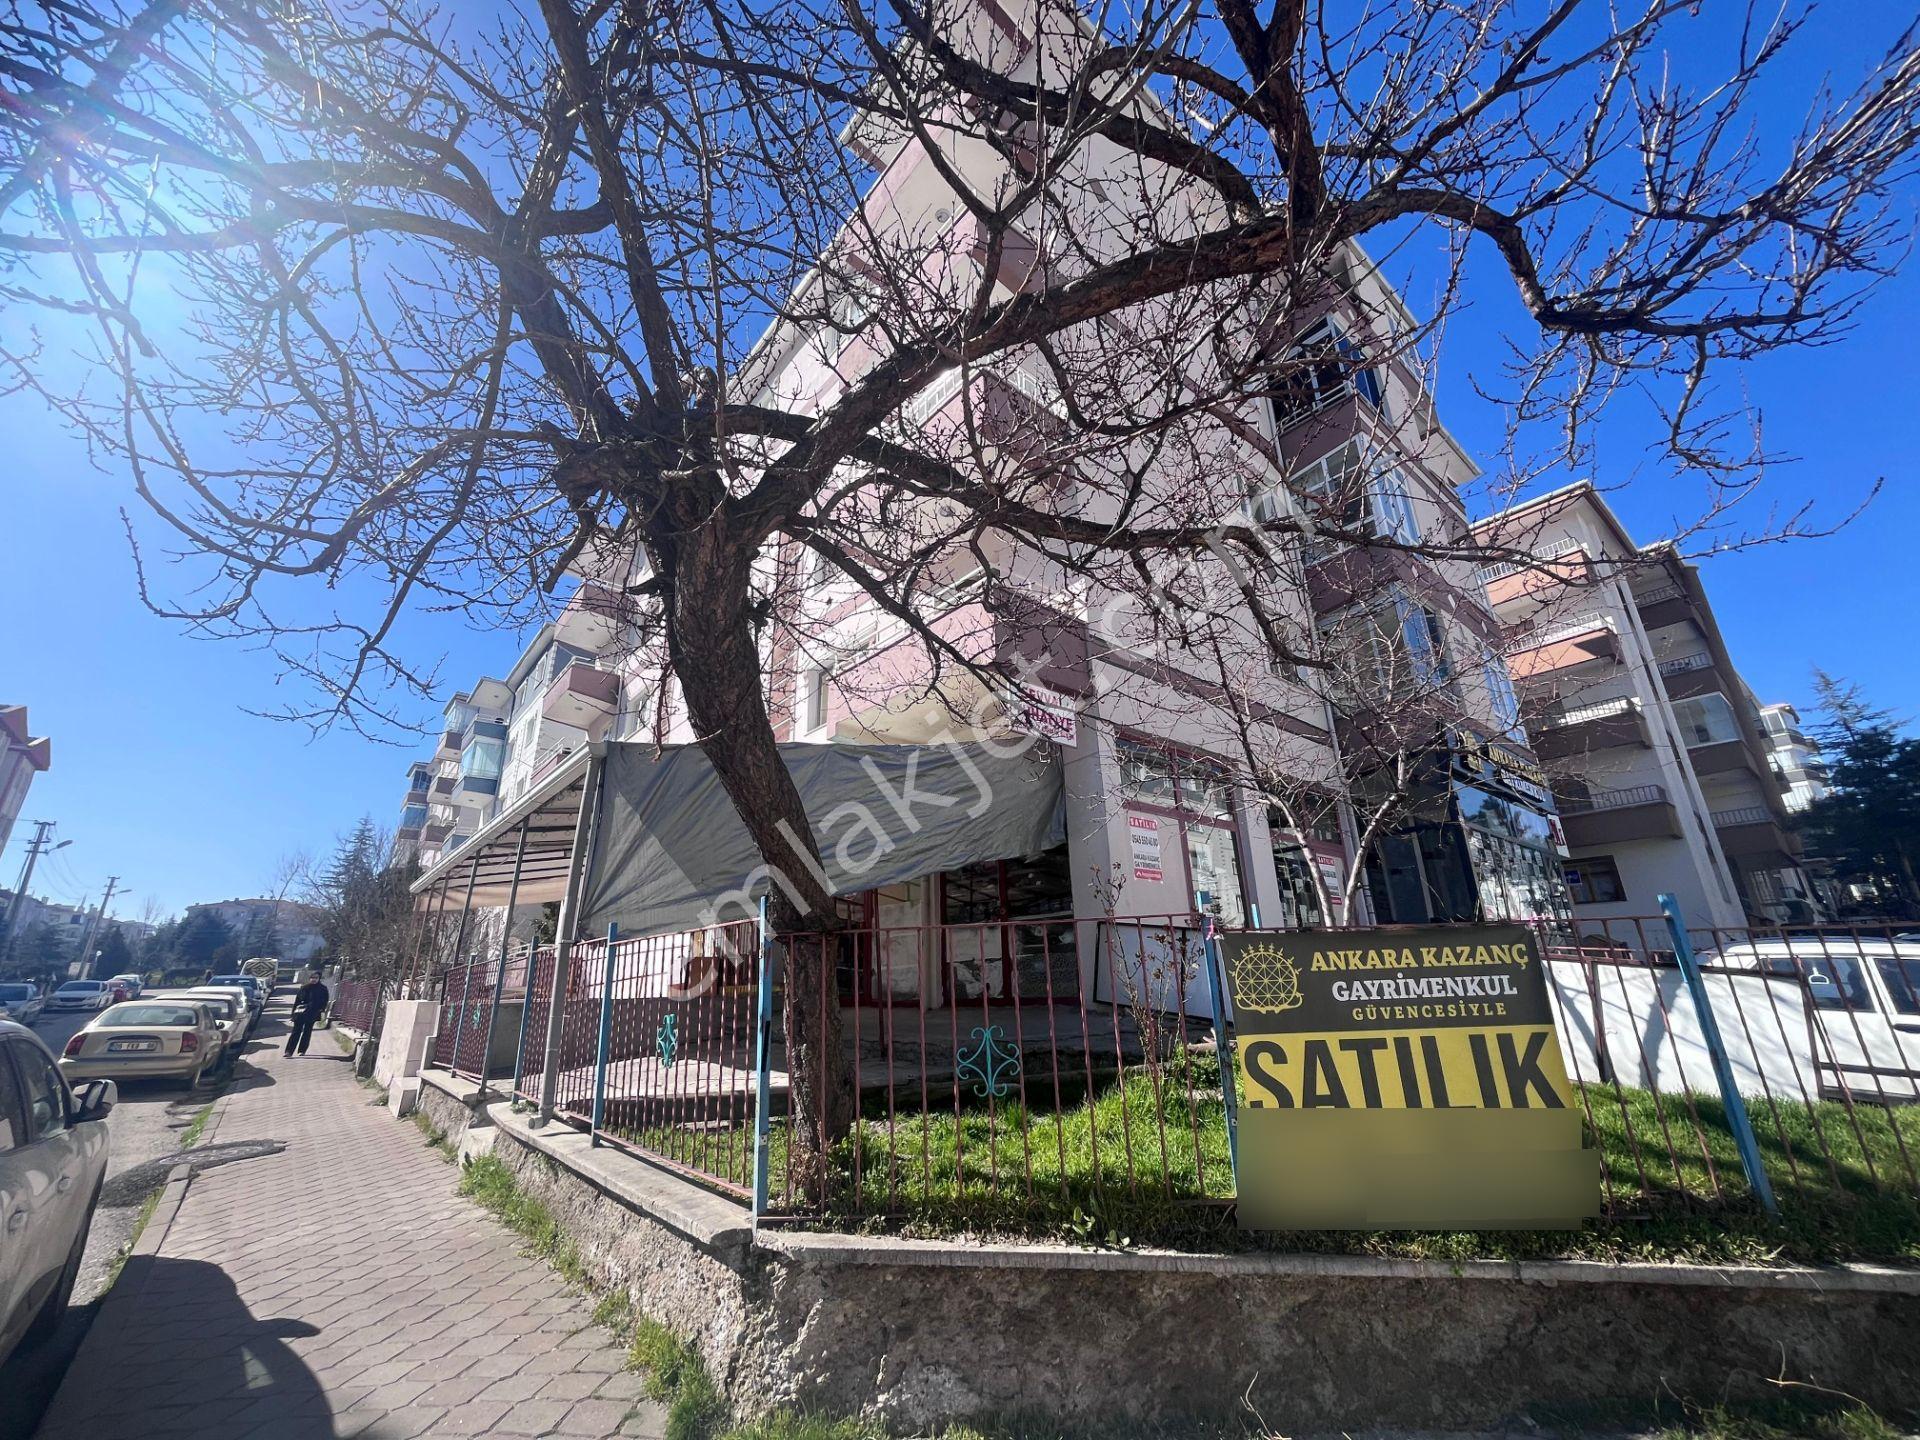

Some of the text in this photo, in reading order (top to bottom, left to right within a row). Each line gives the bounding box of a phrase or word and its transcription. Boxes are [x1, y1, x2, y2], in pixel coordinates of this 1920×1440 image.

[1311, 943, 1529, 972] ANKARA KAZANÇ
[1332, 972, 1518, 1002] GAYRİMENKUL
[1352, 1000, 1507, 1021] GÜVENCESİYLE
[1244, 1031, 1567, 1109] SATILIK
